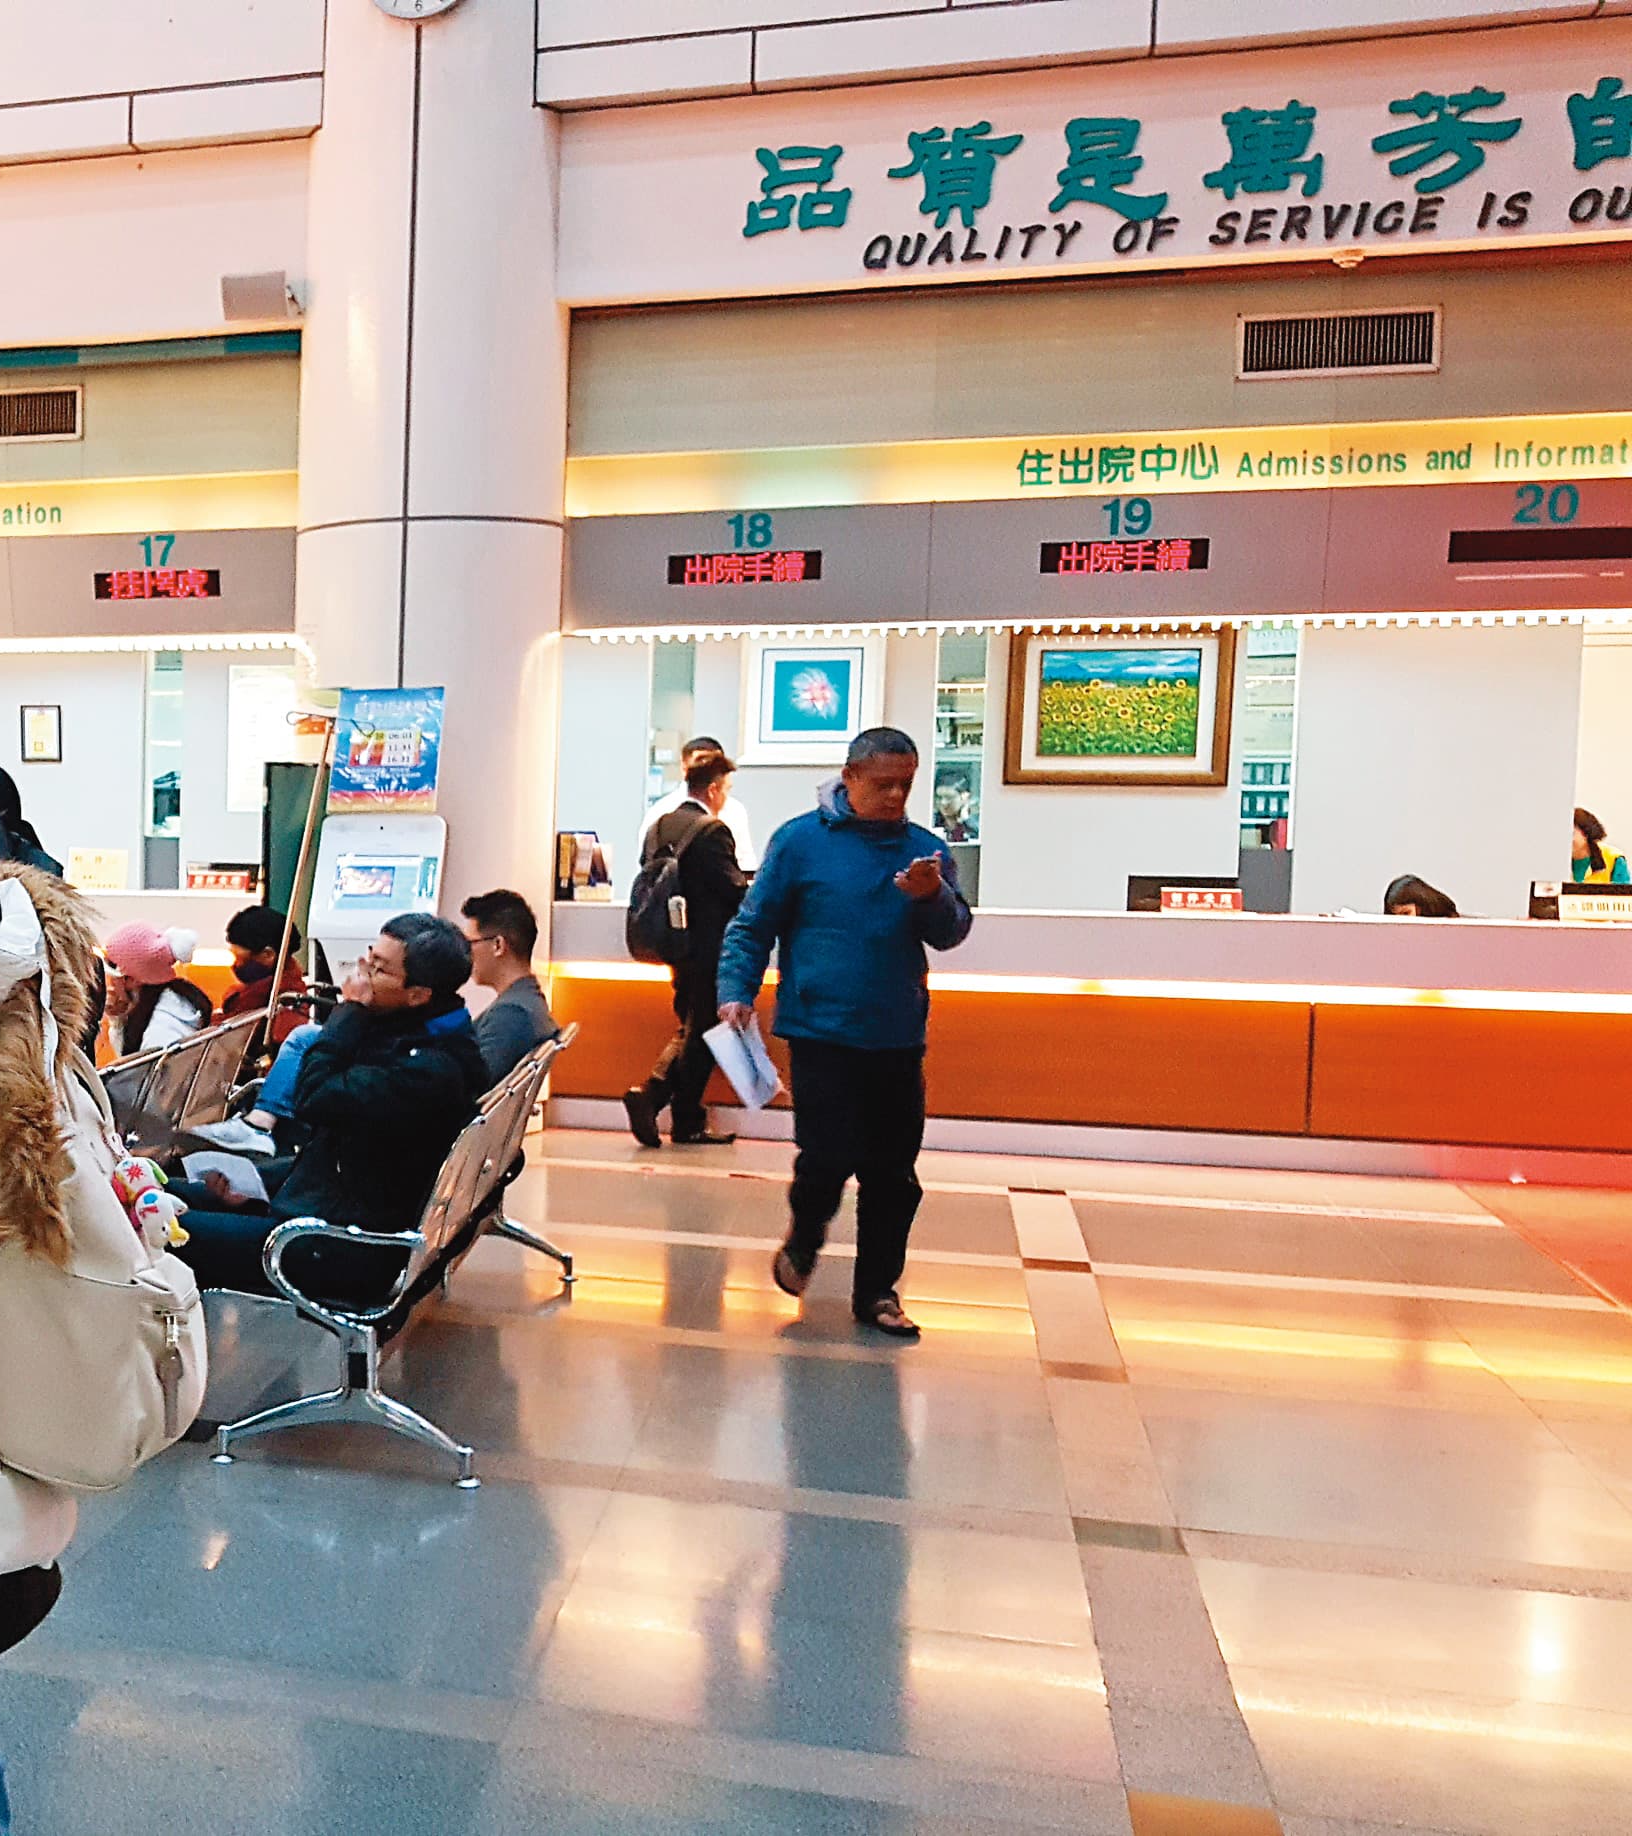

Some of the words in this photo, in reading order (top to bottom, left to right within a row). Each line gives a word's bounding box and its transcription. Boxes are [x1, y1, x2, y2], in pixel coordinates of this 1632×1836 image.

[862, 221, 1081, 270] QUALITY
[1112, 217, 1179, 254] OF
[1208, 196, 1445, 245] SERVICE
[1477, 191, 1533, 230] IS
[1017, 441, 1219, 487] 住出院中心
[1236, 452, 1408, 479] Admissions
[1425, 443, 1472, 471] and
[1101, 497, 1153, 537] 19
[1513, 482, 1580, 525] 20
[727, 512, 773, 548] 18
[138, 534, 176, 567] 17
[683, 550, 806, 586] 出院手續
[1056, 538, 1191, 576] 出院手續
